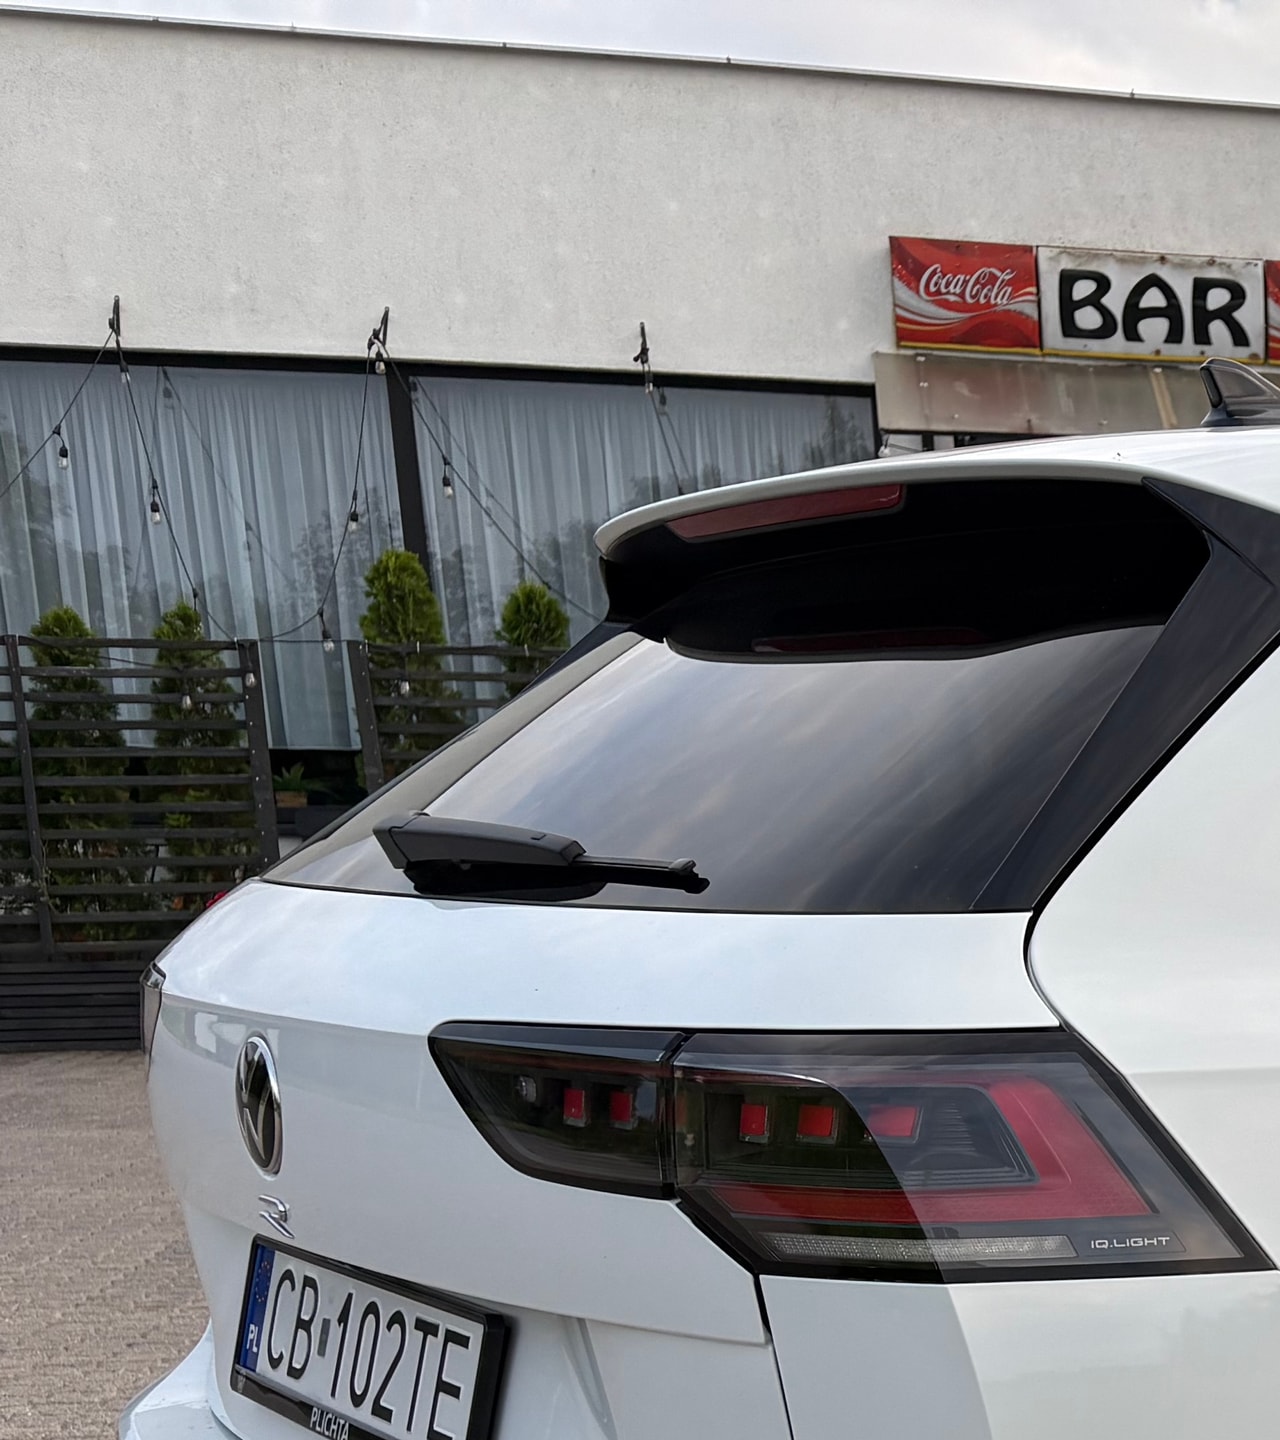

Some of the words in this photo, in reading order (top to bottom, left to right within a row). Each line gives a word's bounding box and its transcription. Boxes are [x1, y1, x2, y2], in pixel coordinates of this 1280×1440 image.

[1059, 268, 1250, 348] BAR
[1090, 1236, 1171, 1249] IQ.LIGHT
[246, 1322, 260, 1353] PL
[266, 1268, 321, 1381] CB
